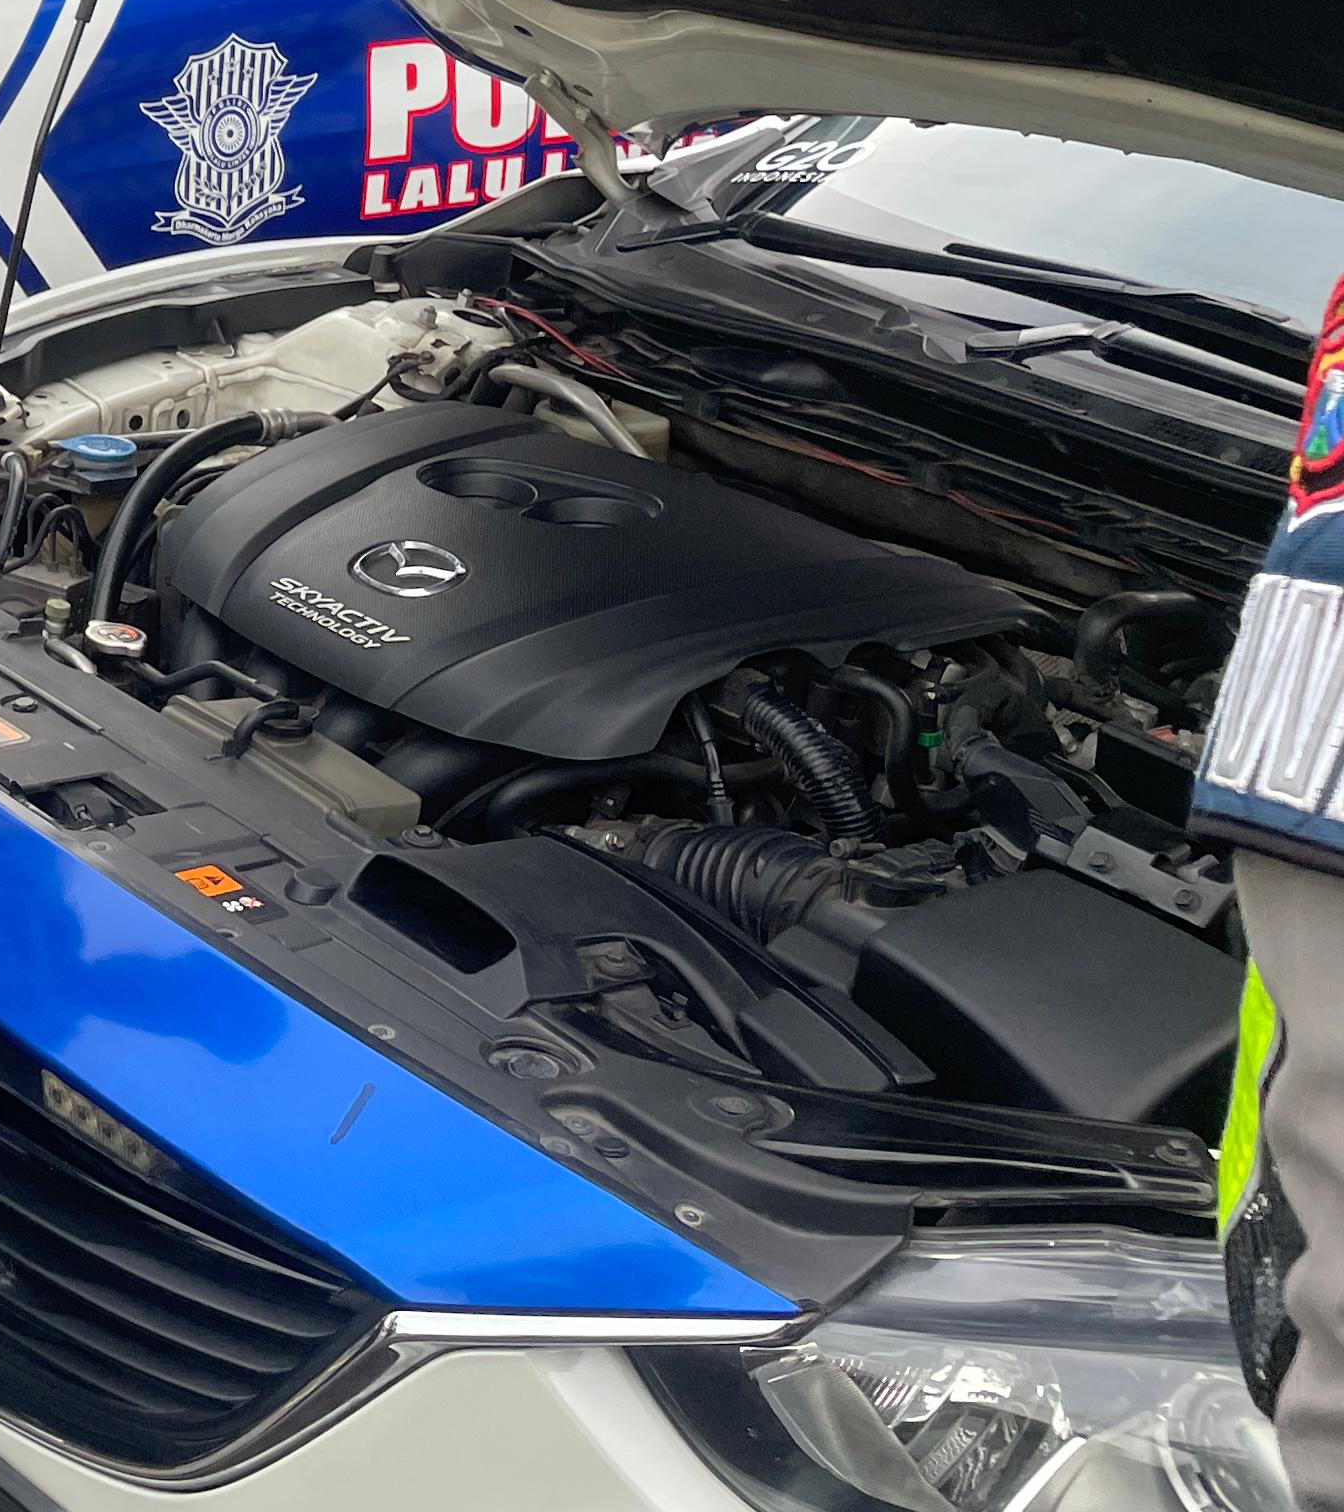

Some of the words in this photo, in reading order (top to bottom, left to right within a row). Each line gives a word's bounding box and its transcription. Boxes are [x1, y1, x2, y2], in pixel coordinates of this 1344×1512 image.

[363, 155, 524, 217] LALU
[755, 140, 876, 172] G20
[269, 591, 382, 649] TECHNOLOGY
[270, 577, 411, 642] SKYACTIV
